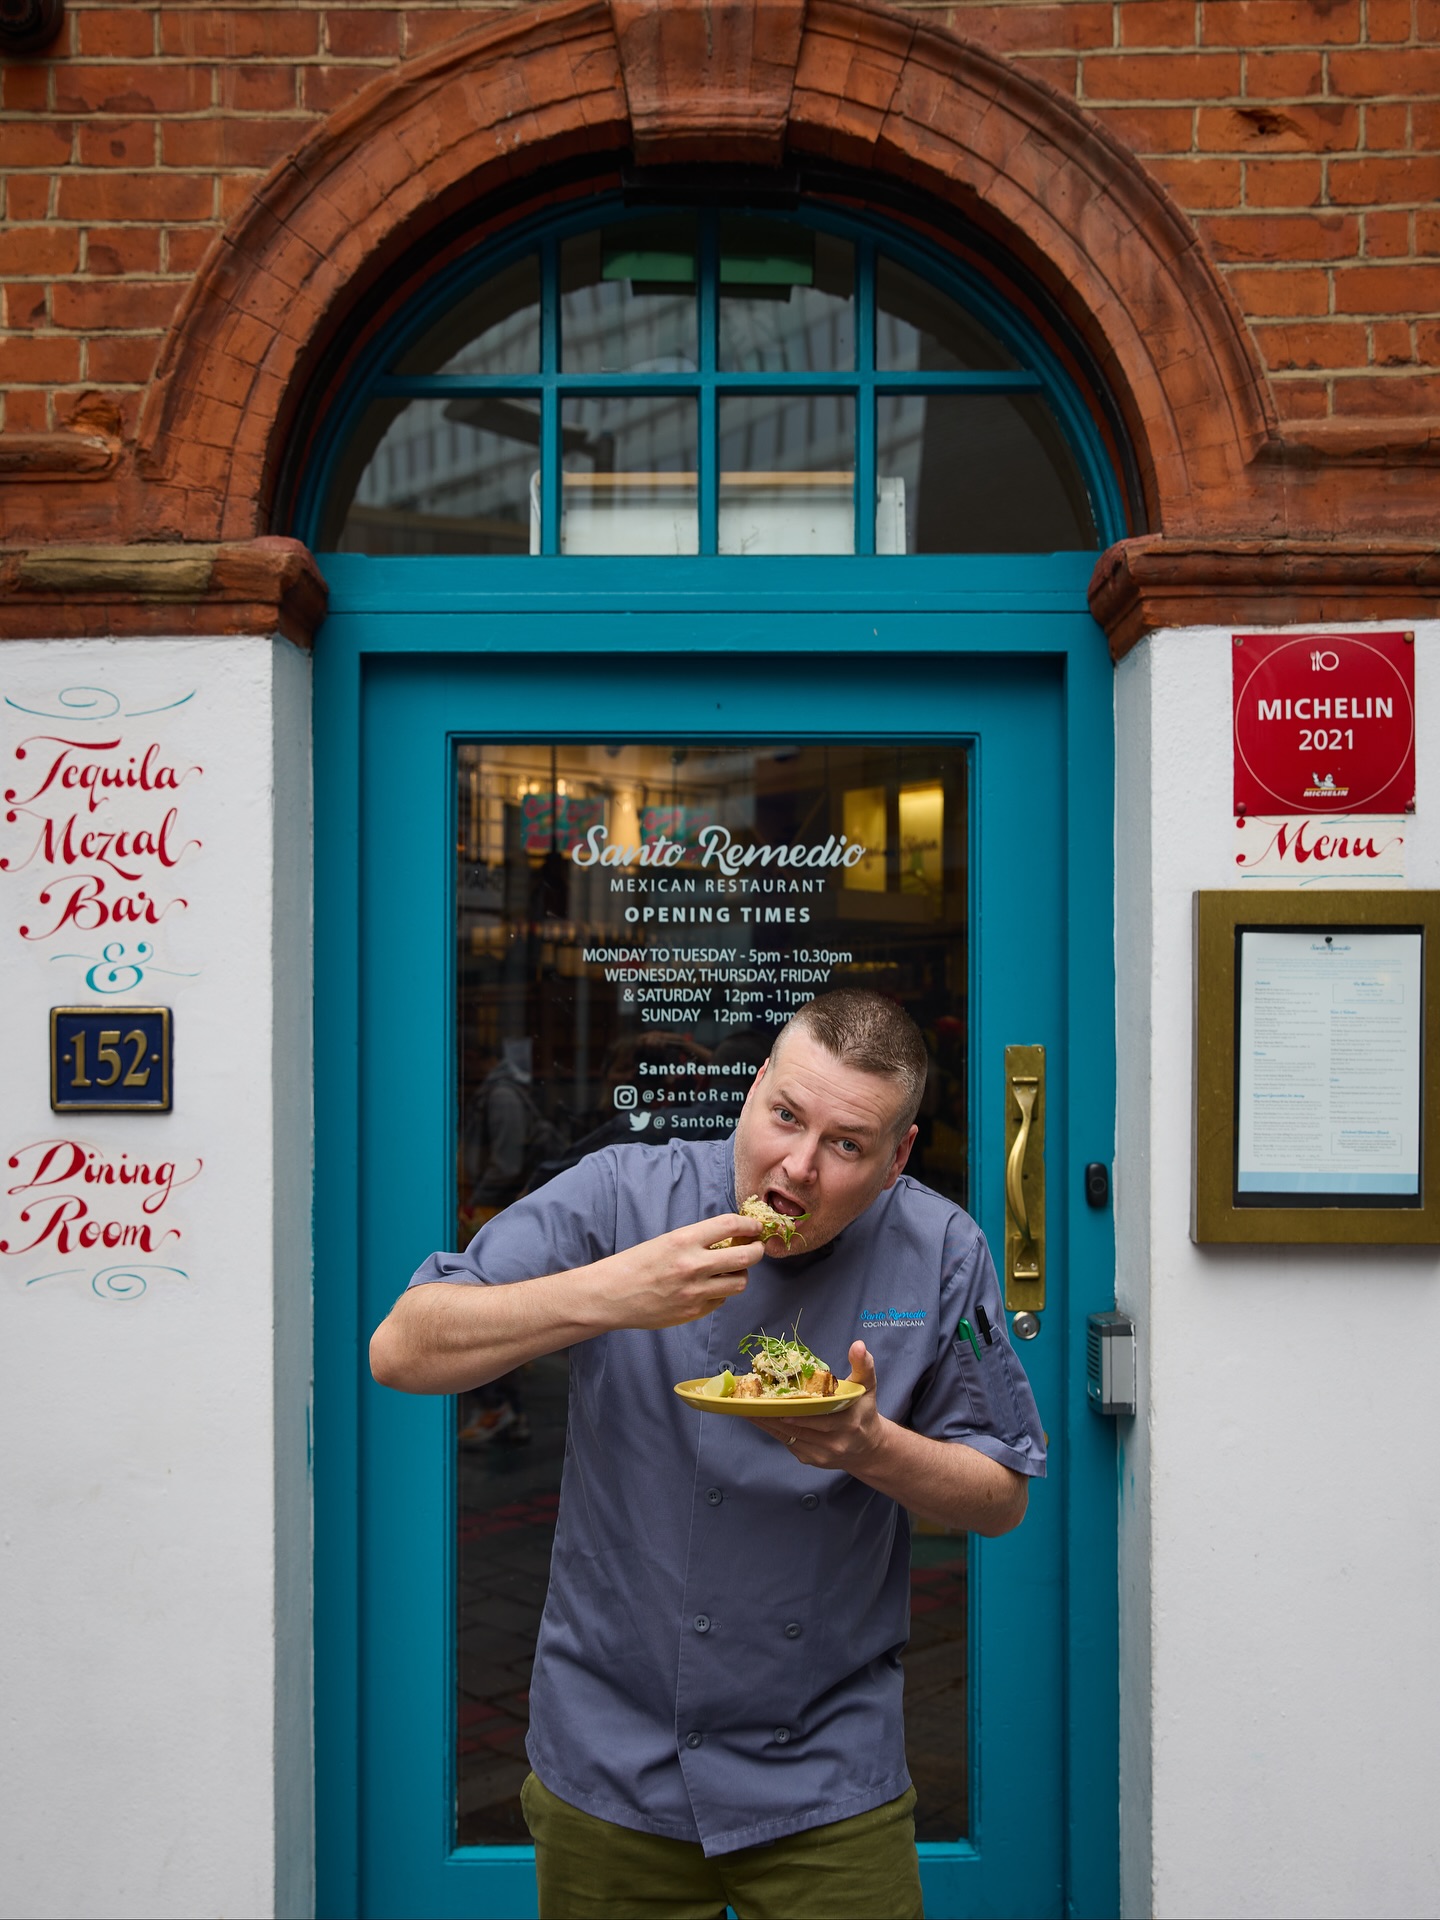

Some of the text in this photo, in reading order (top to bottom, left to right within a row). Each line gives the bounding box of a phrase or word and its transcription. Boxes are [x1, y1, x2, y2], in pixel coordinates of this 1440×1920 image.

[1257, 697, 1393, 720] MICHELIN
[1298, 729, 1354, 750] 2021
[4, 736, 203, 812] Tequila
[1303, 789, 1349, 797] MICHELIN
[0, 808, 202, 881] Mezcal
[571, 825, 686, 867] Santo
[698, 825, 866, 876] Remedio
[1236, 819, 1403, 867] Menu
[610, 879, 825, 892] MEXICAN RESTAURANT
[19, 875, 188, 941] Bar
[624, 907, 810, 922] OPENING TIMES
[582, 948, 648, 963] MONDAY
[650, 948, 670, 963] TO
[672, 948, 737, 963] TUESDAY
[748, 949, 781, 964] 5pm
[792, 949, 853, 964] 10.30pm
[85, 942, 154, 995] &
[604, 968, 831, 984] WEDNESDAY, THURSDAY, FRIDAY
[622, 988, 635, 1002] &
[637, 988, 712, 1002] SATURDAY
[724, 989, 764, 1005] 12pm
[775, 989, 815, 1005] 11pm
[641, 1009, 701, 1022] SUNDAY
[713, 1009, 753, 1026] 12pm
[69, 1029, 151, 1088] 152
[639, 1062, 757, 1075] SantoRemedio
[8, 1139, 202, 1214] Dining
[0, 1195, 181, 1254] Room
[860, 1309, 886, 1320] Santo
